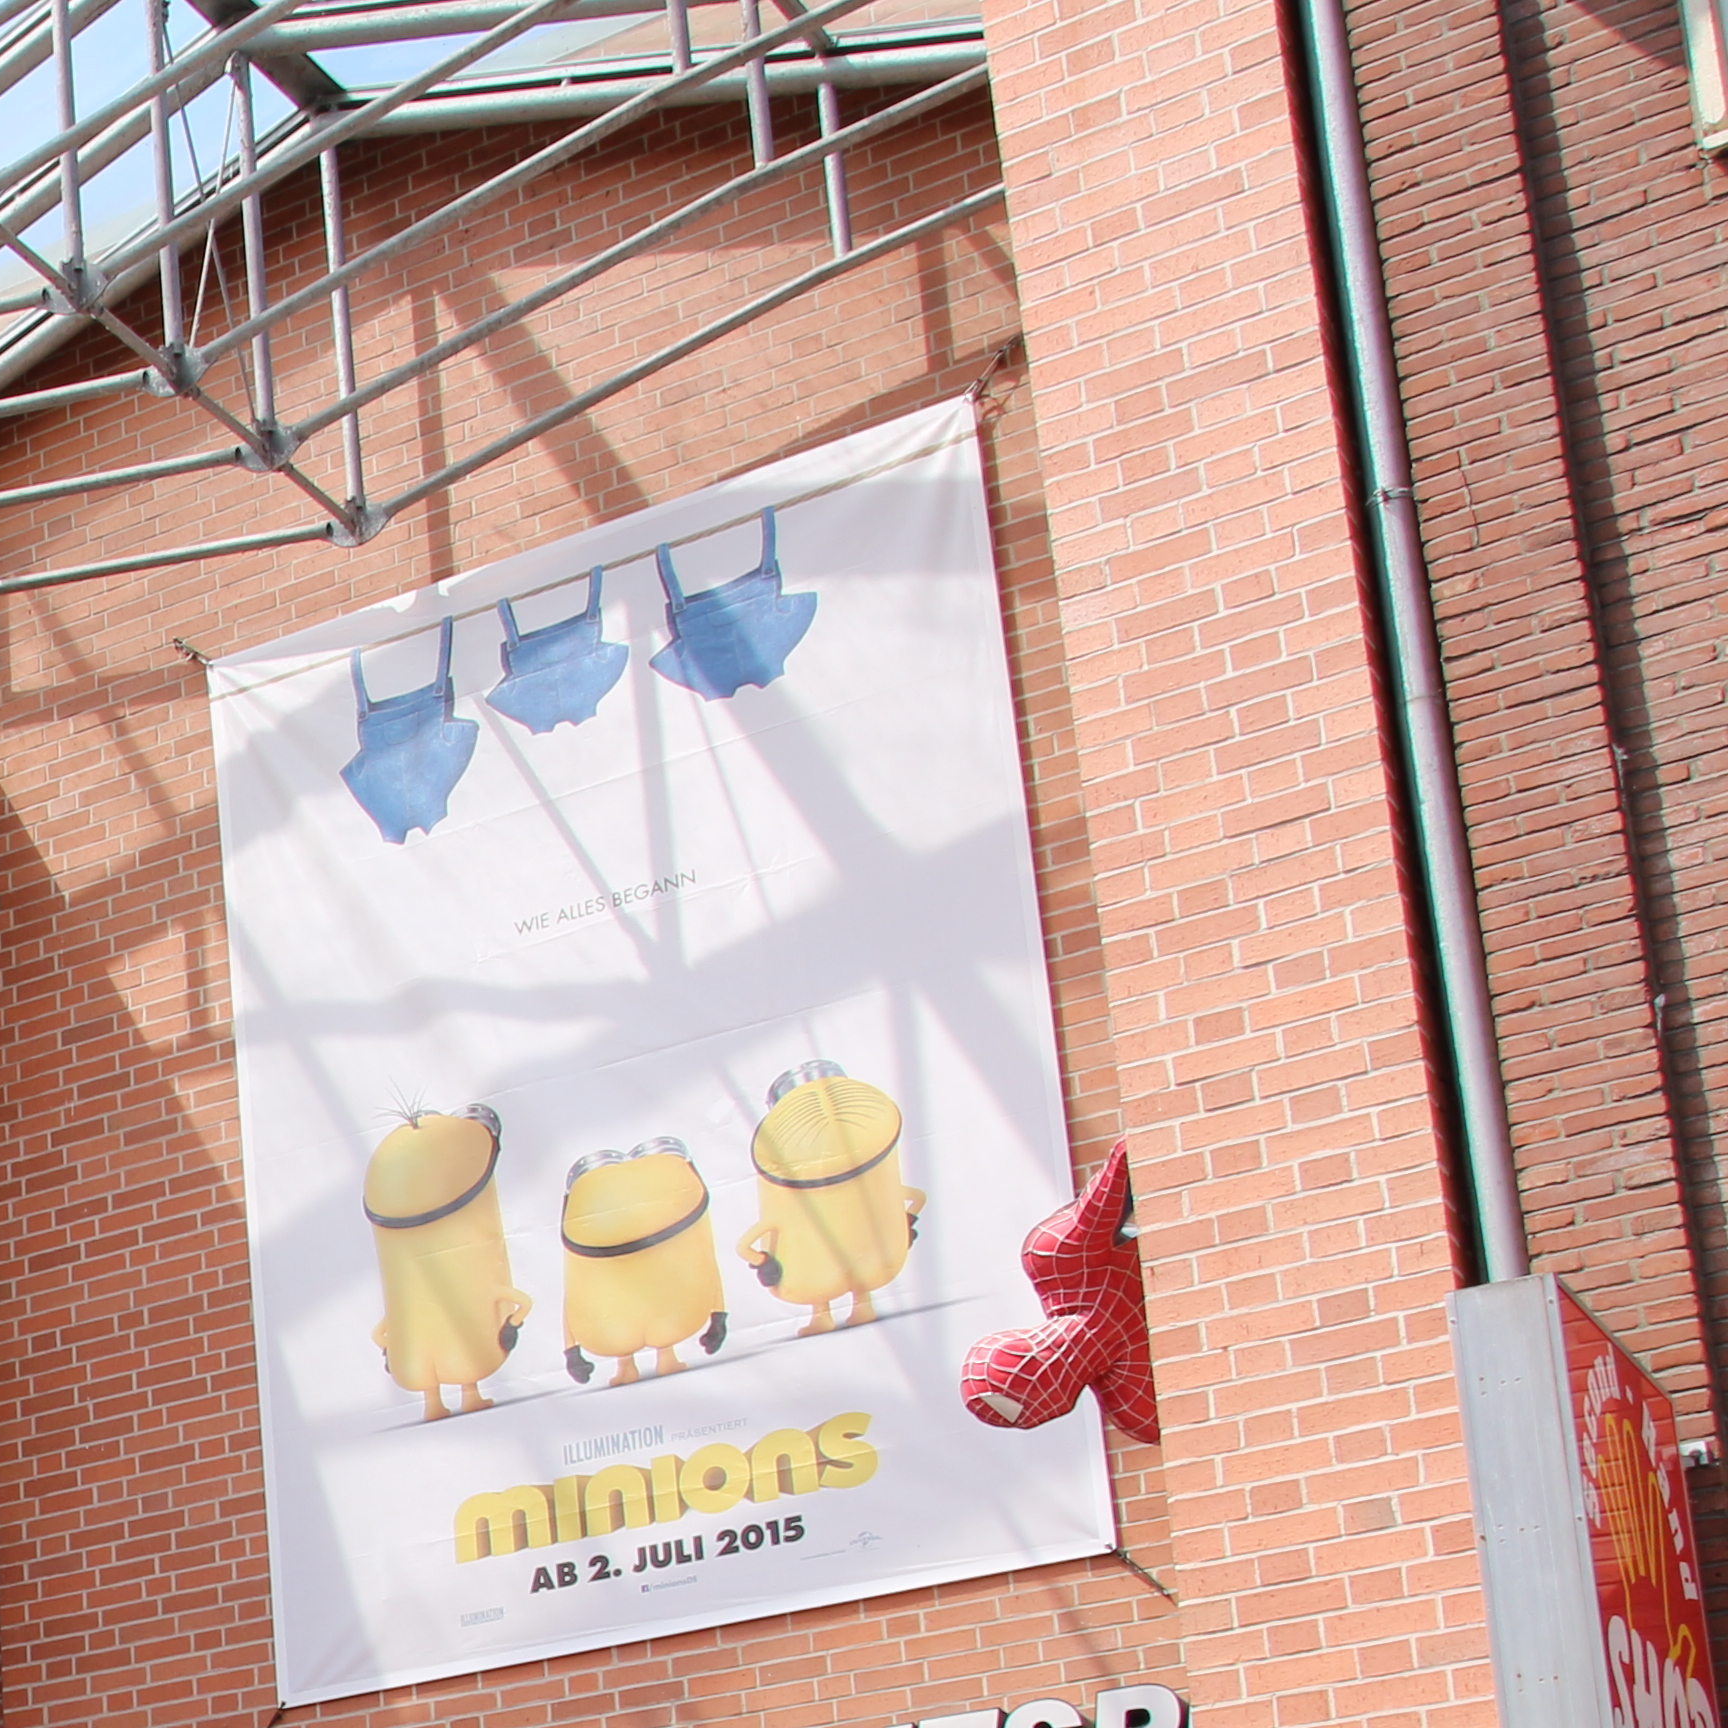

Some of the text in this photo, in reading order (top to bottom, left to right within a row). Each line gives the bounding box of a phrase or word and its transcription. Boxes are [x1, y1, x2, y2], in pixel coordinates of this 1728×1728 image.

[514, 869, 697, 936] WIE ALLES BEGANN
[562, 1417, 748, 1466] ILLUMINATION PRÄSENTIERT
[530, 1561, 578, 1593] AB
[587, 1554, 622, 1583] 2.
[632, 1534, 704, 1574] JULI
[716, 1515, 806, 1557] 2015
